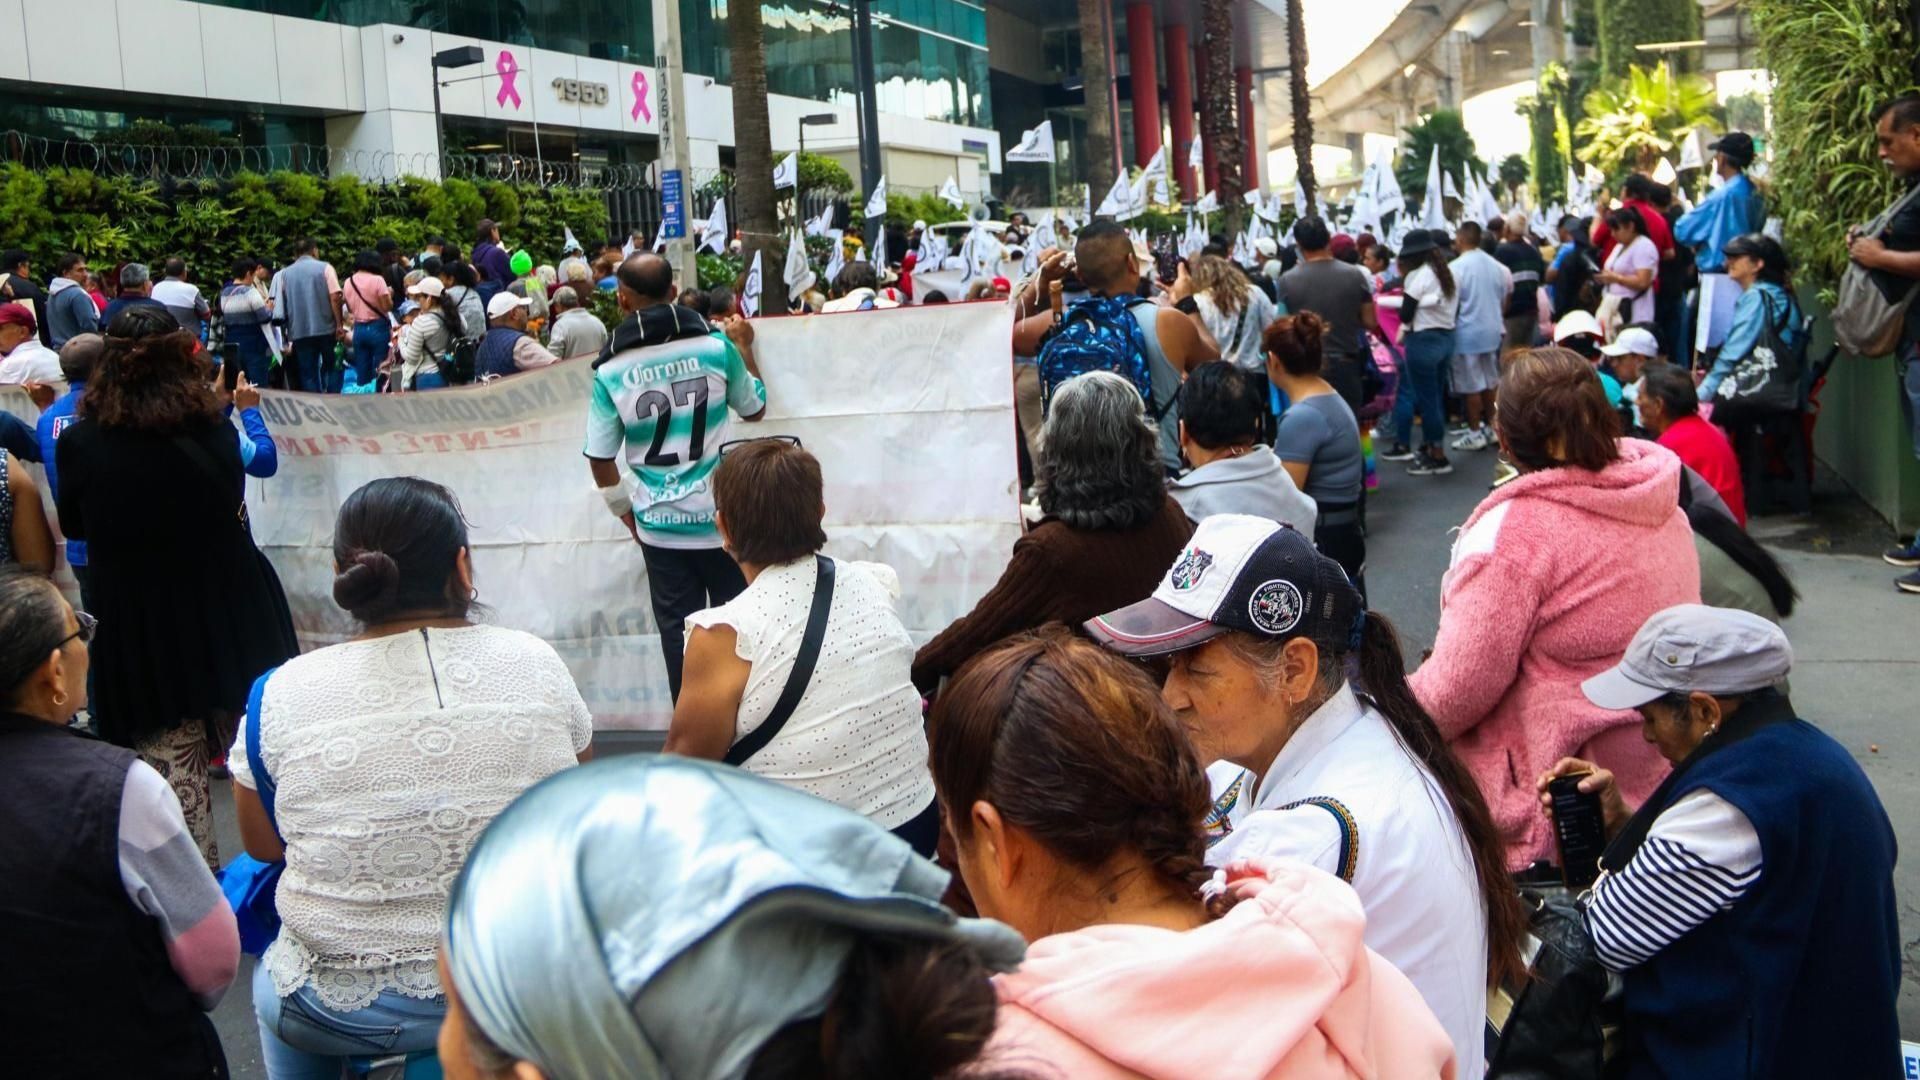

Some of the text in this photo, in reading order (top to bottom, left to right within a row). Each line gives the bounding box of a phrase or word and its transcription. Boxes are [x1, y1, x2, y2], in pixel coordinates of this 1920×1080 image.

[552, 77, 609, 105] 1950
[660, 72, 670, 151] 12547
[623, 355, 701, 389] Corona
[635, 375, 709, 466] 27
[643, 508, 716, 525] Banamex
[1264, 584, 1289, 592] FIGHTING
[1272, 617, 1294, 630] ORIGINAL
[1905, 1056, 1920, 1080] E
